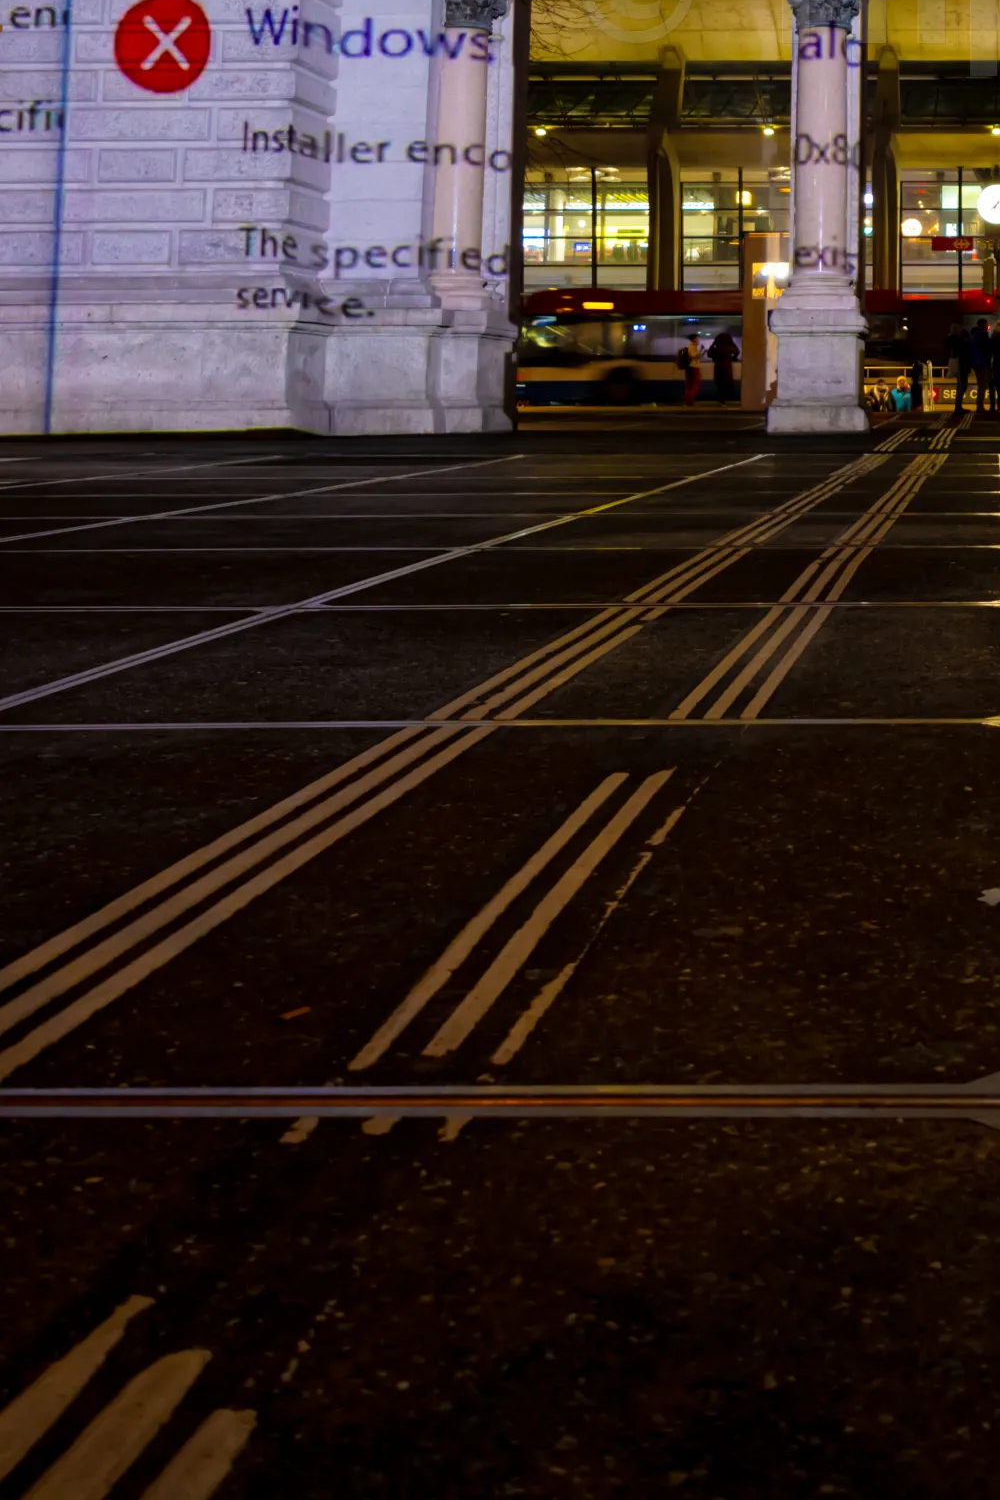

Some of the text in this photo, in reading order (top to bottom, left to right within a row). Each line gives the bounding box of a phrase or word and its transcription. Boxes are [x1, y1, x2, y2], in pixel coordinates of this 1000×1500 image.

[246, 4, 494, 64] Windows
[242, 120, 511, 174] Installer enco
[239, 225, 510, 280] The specified
[235, 282, 376, 320] service.
